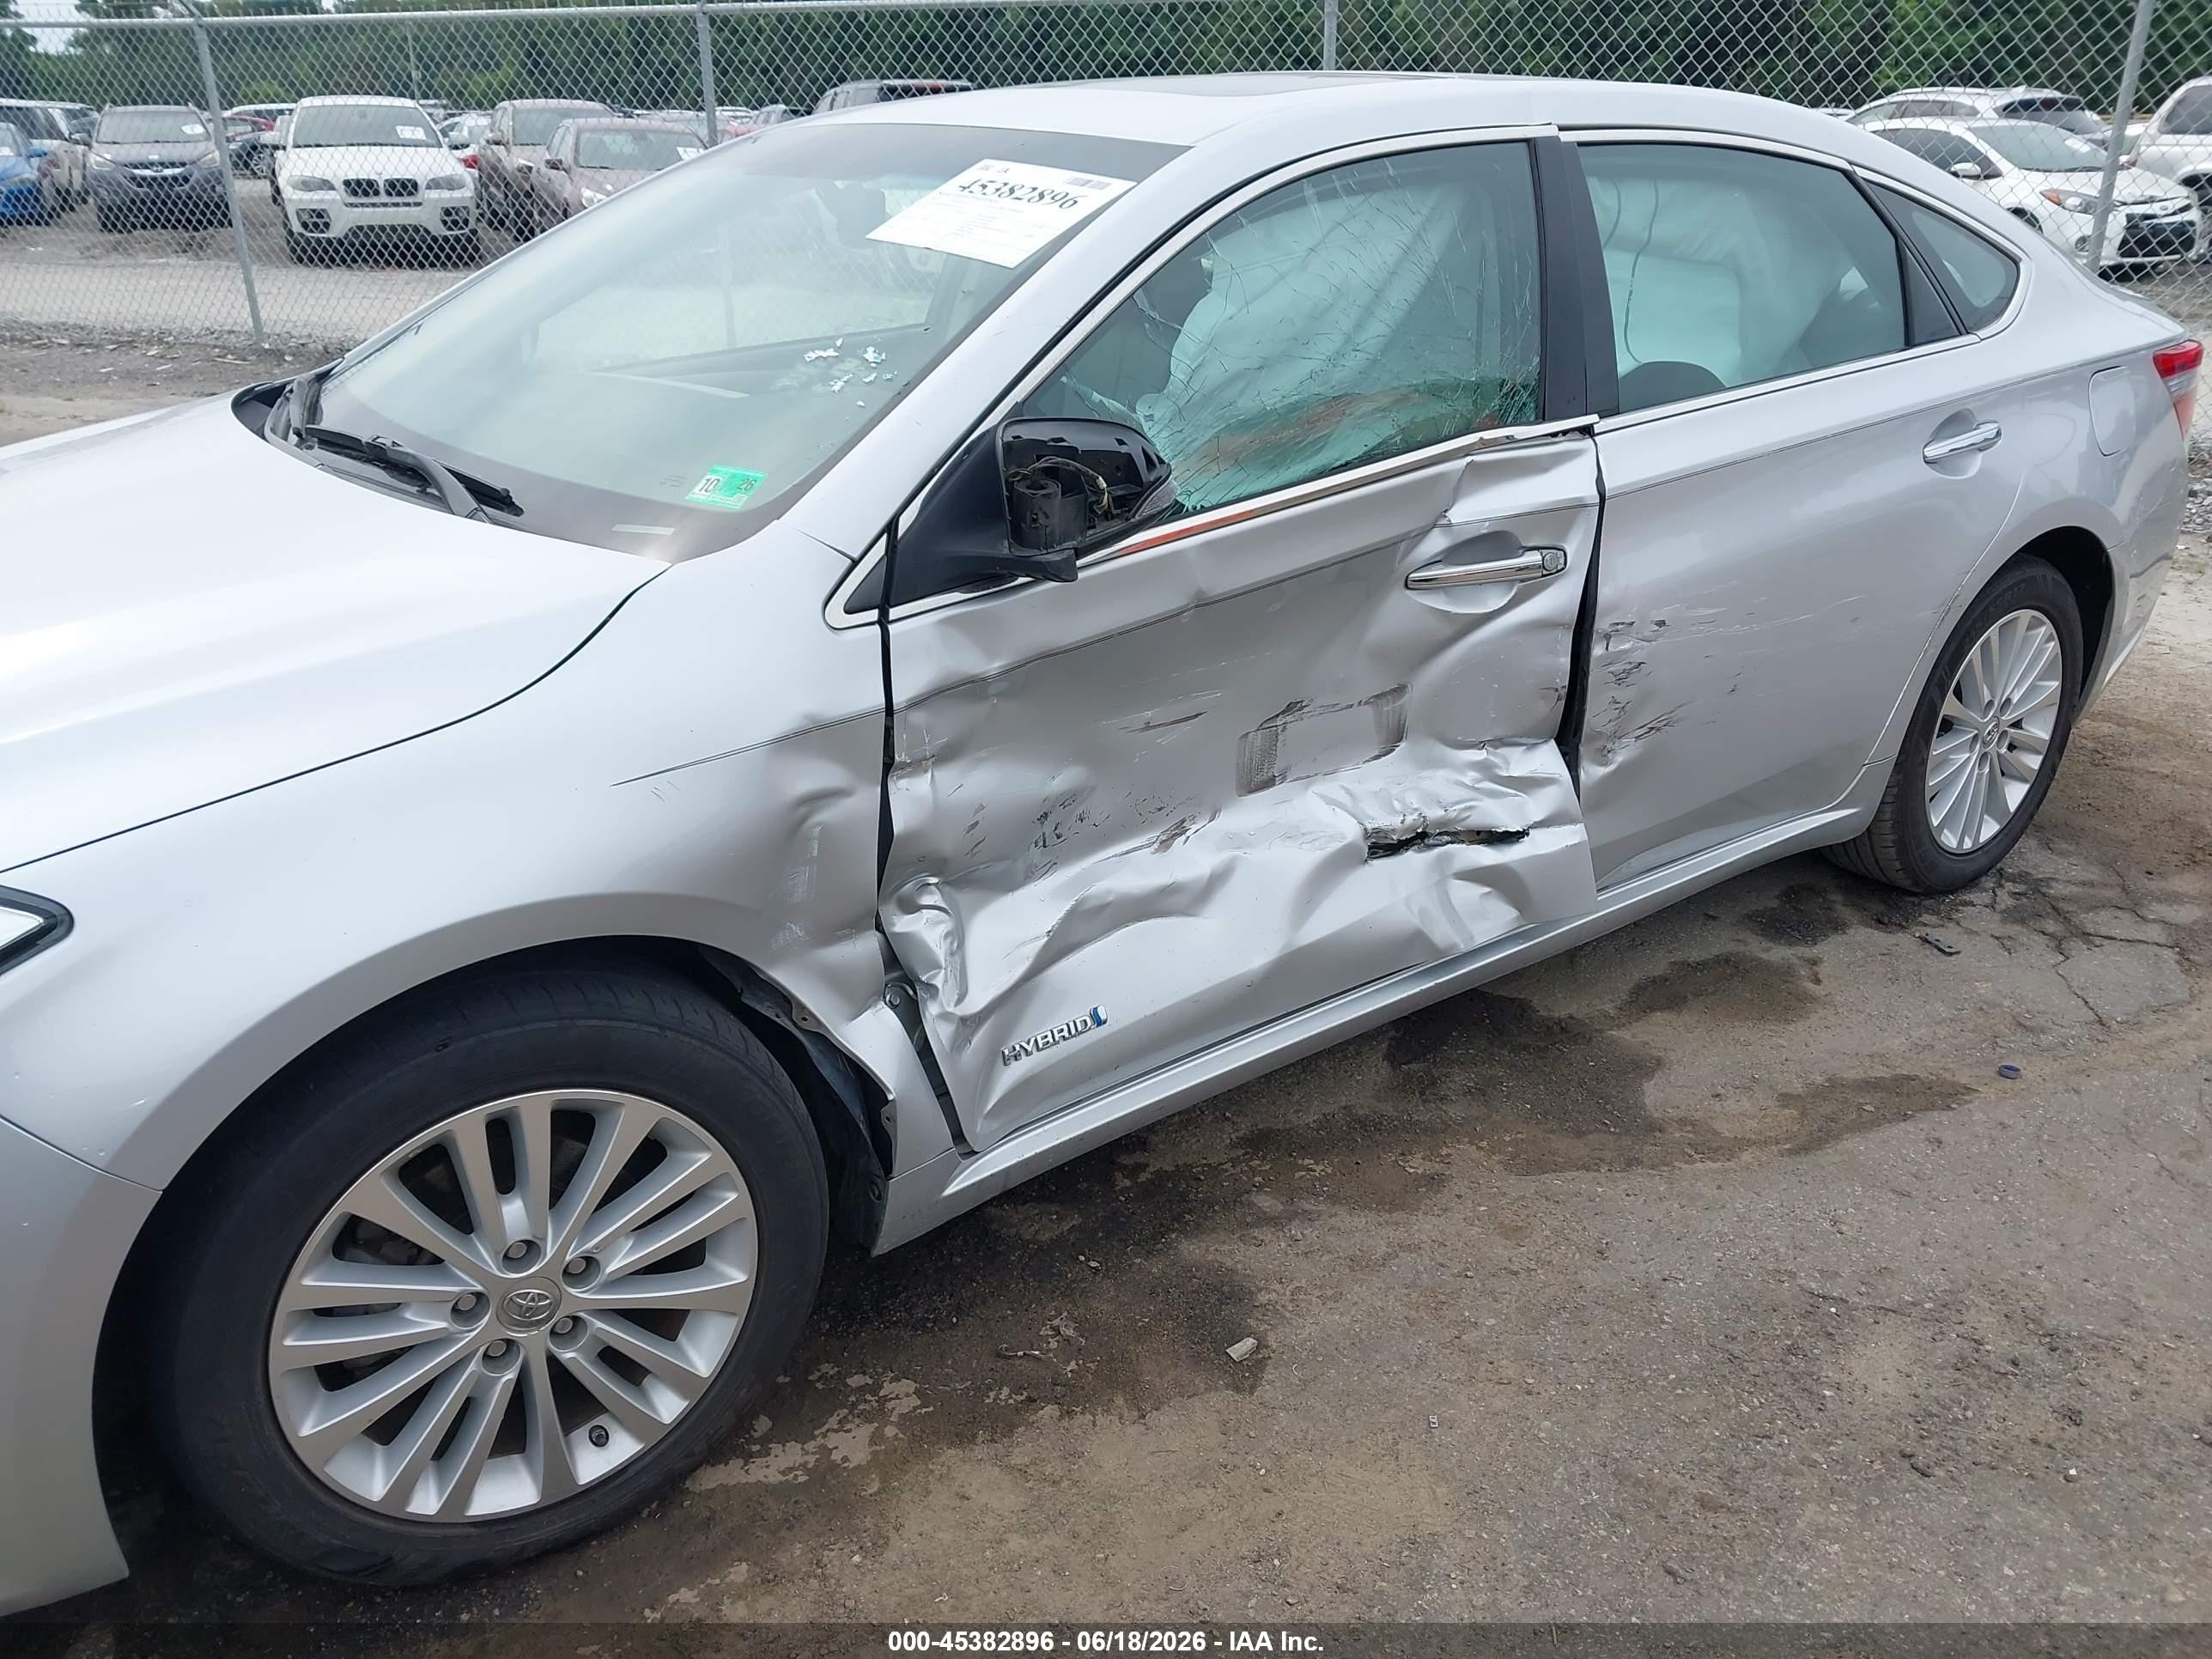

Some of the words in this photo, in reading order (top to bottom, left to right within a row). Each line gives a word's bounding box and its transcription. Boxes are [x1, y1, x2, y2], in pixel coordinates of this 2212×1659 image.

[957, 178, 1088, 210] 45382896
[699, 477, 721, 494] 10
[1001, 1015, 1094, 1066] HYBRID
